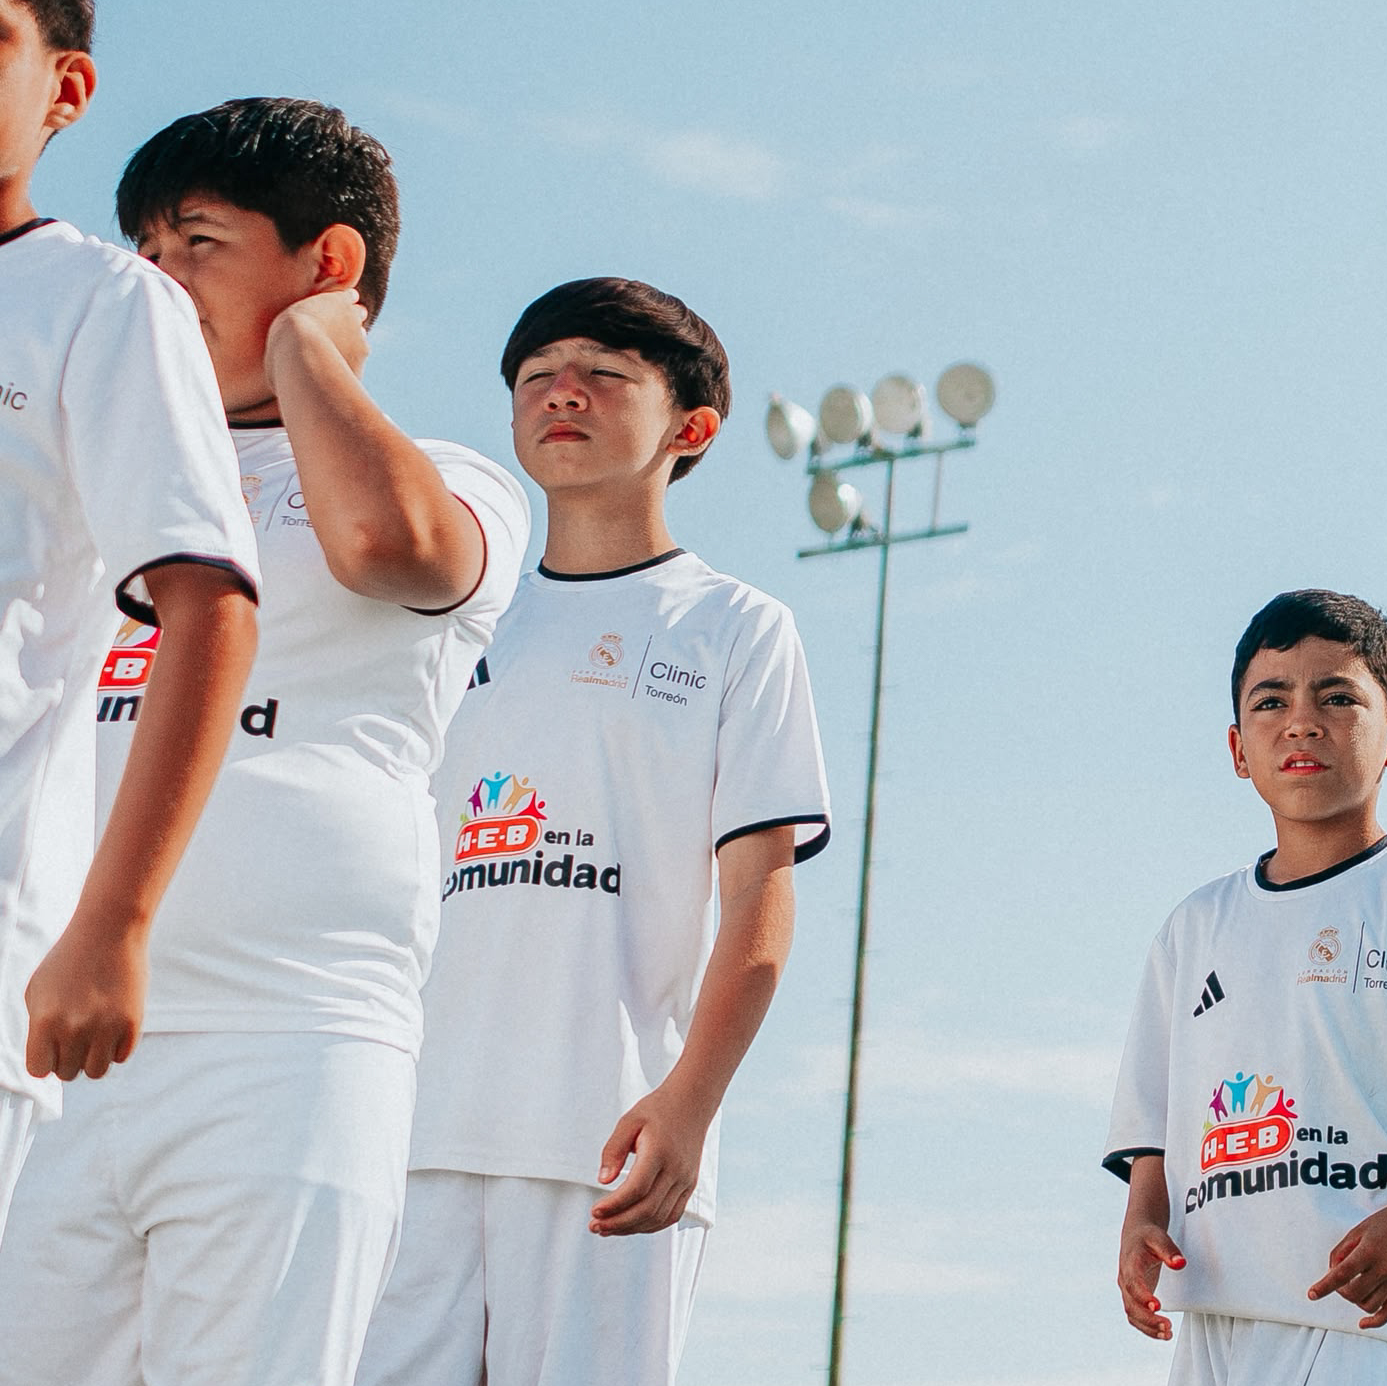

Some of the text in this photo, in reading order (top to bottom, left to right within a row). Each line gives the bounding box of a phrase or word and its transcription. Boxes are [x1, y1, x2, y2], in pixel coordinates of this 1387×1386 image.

[650, 662, 707, 689] Clinic
[645, 685, 688, 706] Torreón
[544, 830, 570, 846] en
[575, 829, 594, 846] la
[441, 850, 621, 902] omunidad
[1296, 1126, 1322, 1142] en
[1327, 1125, 1348, 1145] la
